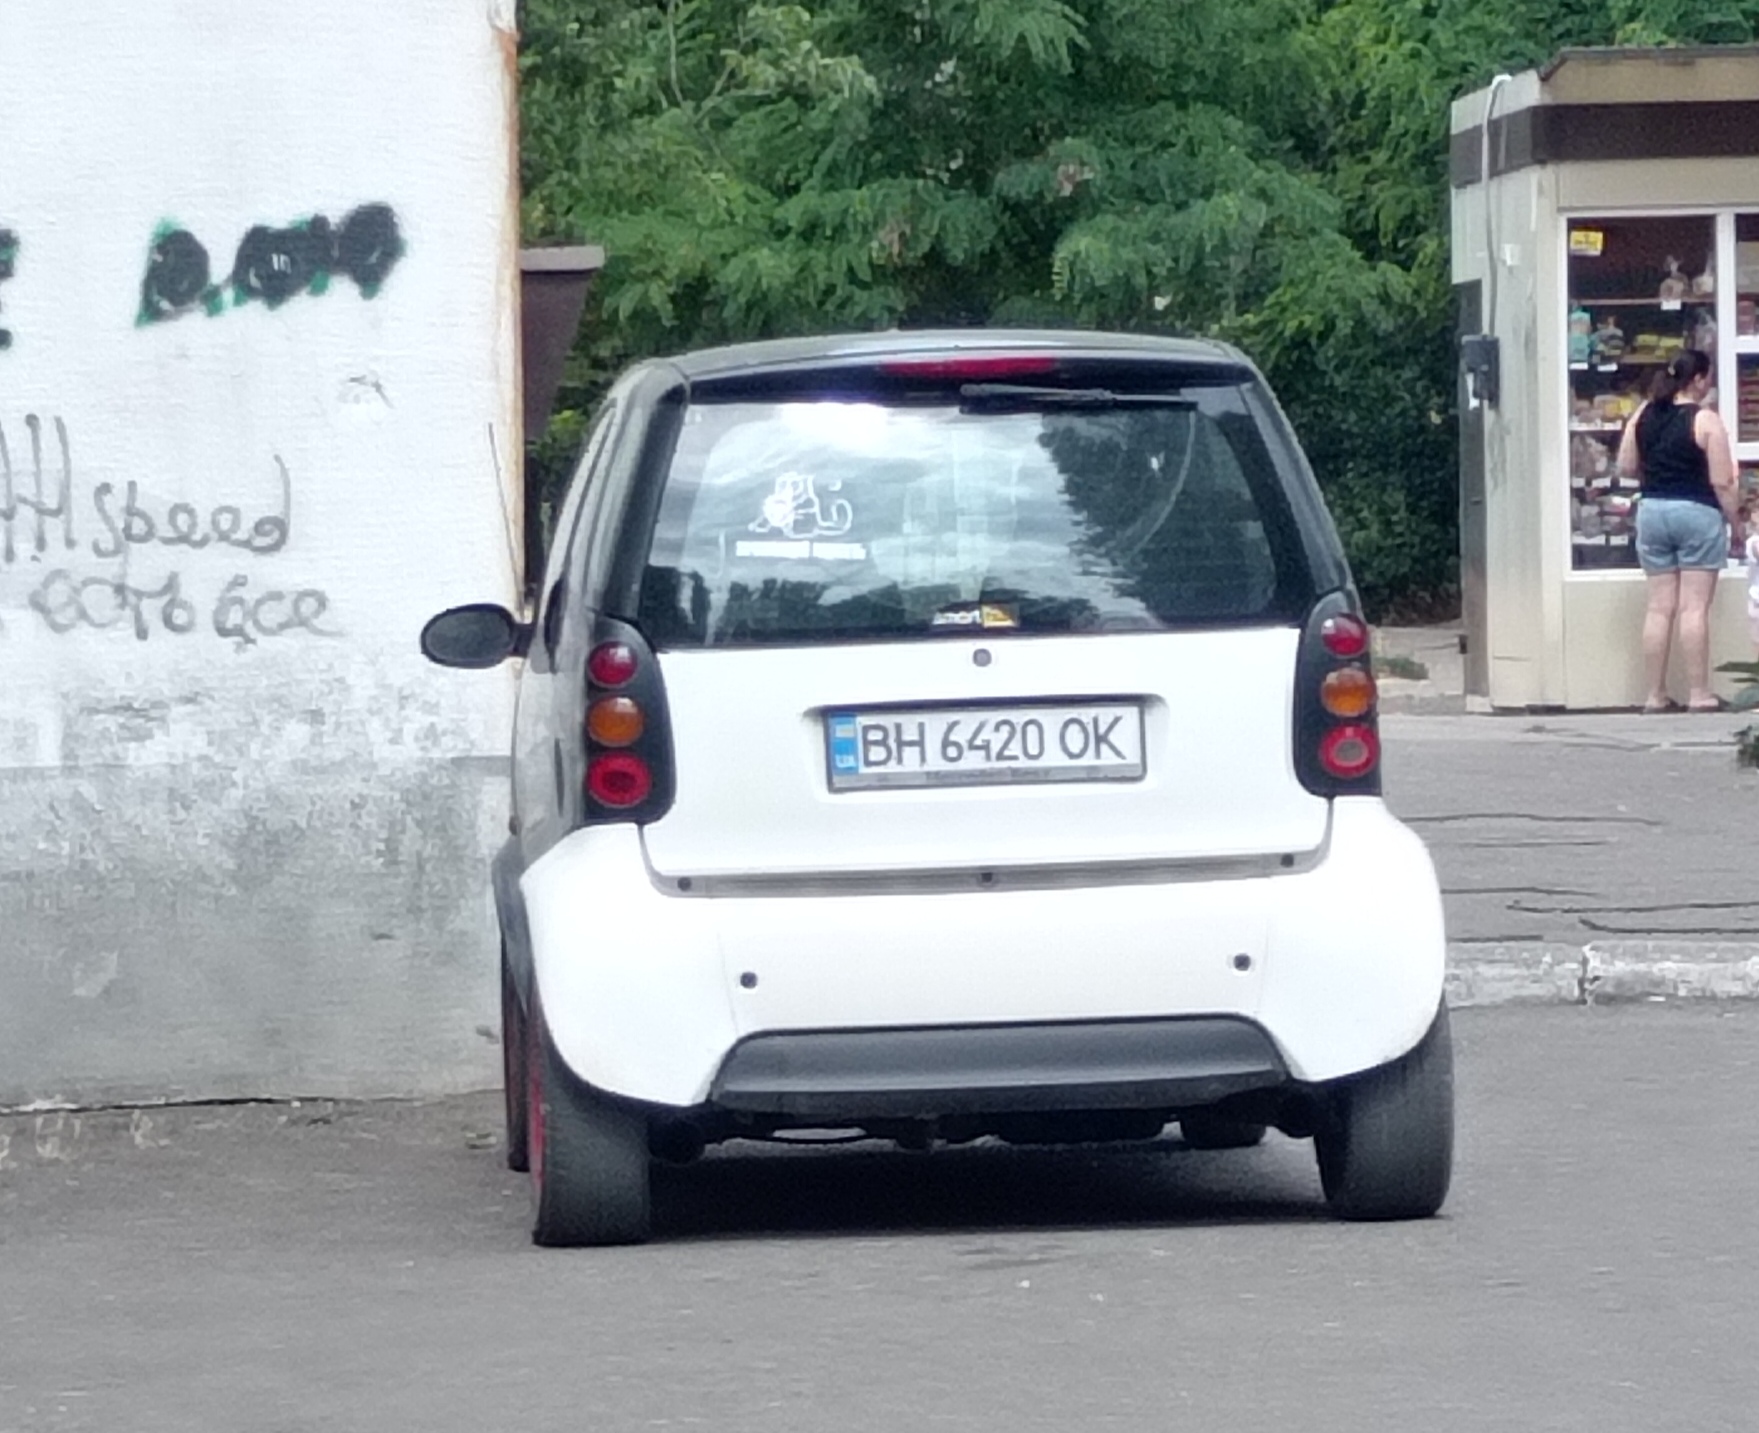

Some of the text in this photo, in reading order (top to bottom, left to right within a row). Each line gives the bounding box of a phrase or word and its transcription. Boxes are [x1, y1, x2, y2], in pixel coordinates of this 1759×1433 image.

[861, 715, 1128, 768] BH 6420 OK
